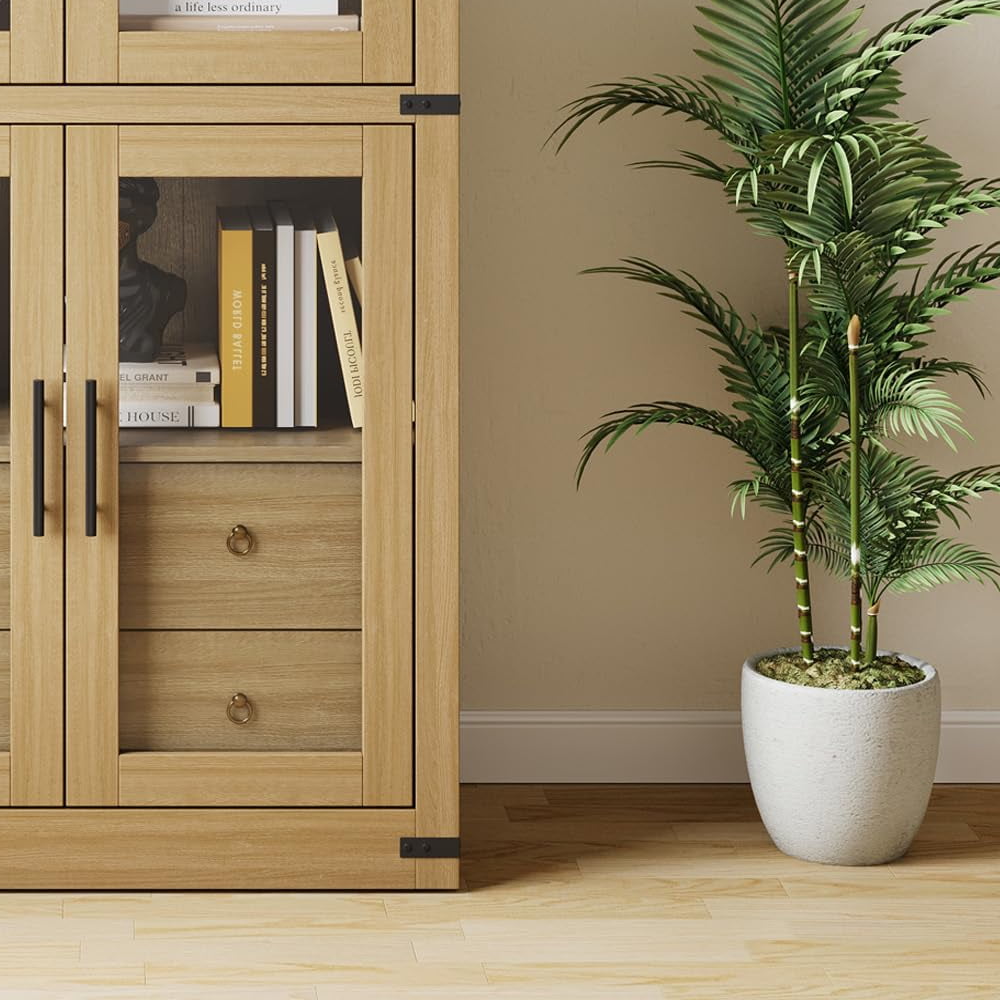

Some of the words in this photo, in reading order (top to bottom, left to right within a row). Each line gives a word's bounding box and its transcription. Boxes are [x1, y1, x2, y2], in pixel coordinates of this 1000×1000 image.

[175, 3, 182, 12] a
[185, 1, 204, 12] life
[207, 1, 228, 12] less
[231, 1, 282, 14] ordinary
[134, 373, 169, 382] GRANT
[127, 411, 180, 423] HOUSE
